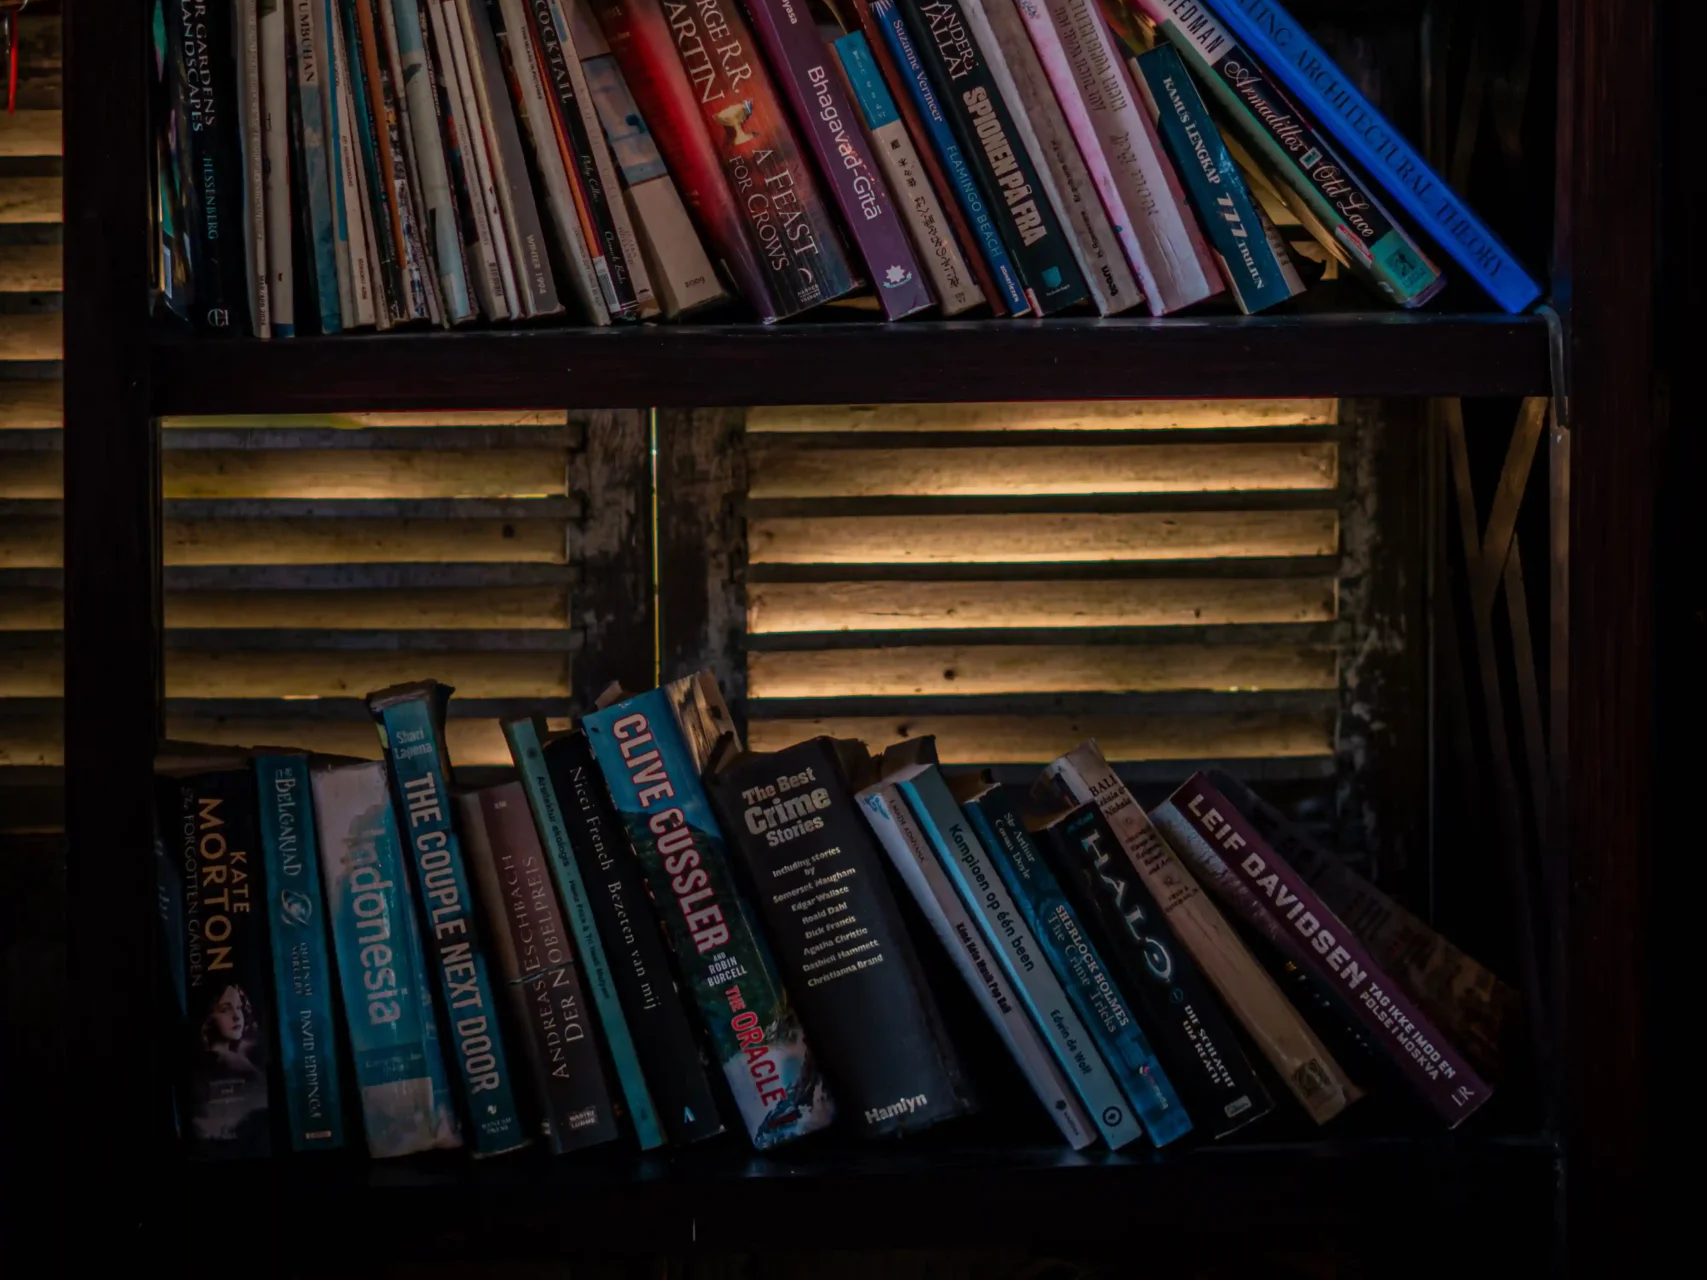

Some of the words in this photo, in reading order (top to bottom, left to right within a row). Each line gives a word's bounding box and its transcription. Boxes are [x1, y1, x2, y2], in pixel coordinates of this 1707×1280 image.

[195, 6, 215, 125] GARDENS
[715, 39, 757, 95] R.R.
[891, 18, 922, 71] Suzanne
[913, 69, 944, 124] Vermeer
[919, 0, 968, 82] JALLAI
[960, 83, 1018, 177] SPIONEN
[1161, 76, 1190, 123] KAMUS
[1183, 122, 1222, 187] LENGKAP
[1219, 52, 1309, 156] Armadillos
[1308, 159, 1350, 203] Old
[1334, 191, 1380, 241] Lace
[997, 169, 1033, 204] PÅ
[1291, 45, 1432, 201] ARCHITECTURAL
[1431, 199, 1506, 280] THEORY
[727, 154, 756, 194] FOR
[743, 190, 793, 273] CROWS
[750, 142, 775, 164] A
[763, 169, 821, 262] FEAST
[945, 143, 983, 213] FLAMINGO
[975, 213, 1002, 258] BEACH
[1010, 198, 1049, 247] FRA
[525, 233, 541, 269] WINTER
[534, 271, 546, 294] 1994
[1235, 239, 1265, 290] TRILIUN
[396, 730, 425, 744] Shari
[402, 771, 442, 827] THE
[741, 780, 777, 807] The
[775, 766, 817, 793] Best
[741, 784, 834, 837] Crime
[1088, 774, 1118, 797] BALI
[536, 775, 557, 823] Arsitektur
[549, 824, 570, 867] ekologis
[568, 765, 595, 811] Nicci
[584, 815, 614, 871] French
[610, 710, 676, 808] CLIVE
[646, 804, 733, 955] CUSSLER
[764, 814, 826, 848] Stories
[992, 817, 1016, 852] Conan
[1010, 851, 1032, 881] Doyle
[1003, 811, 1018, 828] Sir
[1012, 827, 1037, 863] Arthur
[182, 814, 199, 914] FORGOTTEN
[196, 796, 233, 971] MORTON
[230, 851, 251, 914] KATE
[415, 829, 467, 940] COUPLE
[770, 856, 811, 878] Including
[810, 845, 841, 862] stories
[771, 881, 815, 904] Somerset
[813, 866, 857, 888] Maugham
[803, 866, 816, 877] by
[1185, 792, 1246, 857] LEIF
[1239, 850, 1369, 991] DAVIDSEN
[341, 826, 413, 1025] Indonesia
[499, 853, 541, 971] ESCHBACH
[520, 853, 570, 988] NOBELPREIS
[606, 880, 638, 945] Bezeten
[790, 895, 818, 913] Edgar
[815, 884, 850, 901] Wallace
[801, 909, 827, 925] Roald
[826, 901, 848, 915] Dahl
[803, 925, 825, 939] Dick
[824, 914, 856, 931] Francis
[945, 822, 993, 895] Kampioen
[982, 891, 1002, 912] op
[995, 909, 1017, 937] één
[1010, 935, 1037, 972] been
[1076, 827, 1181, 986] HALO
[187, 919, 203, 986] GARDEN
[628, 948, 646, 977] van
[707, 955, 738, 975] ROBIN
[711, 951, 726, 961] AND
[801, 938, 834, 957] Agatha
[833, 926, 869, 944] Christie
[801, 954, 837, 972] Dashiell
[835, 938, 880, 960] Hammett
[806, 963, 858, 988] Christianna
[855, 953, 884, 970] Brand
[1044, 911, 1065, 935] The
[1062, 942, 1094, 987] Crime
[1088, 988, 1119, 1034] Tricks
[1053, 902, 1099, 974] SHERLOCK
[1092, 971, 1130, 1028] HOLMES
[439, 941, 483, 1013] NEXT
[636, 980, 661, 1011] mij
[705, 963, 748, 987] BURCELL
[723, 984, 747, 1013] THE
[299, 1009, 315, 1051] DAVID
[530, 978, 570, 1081] ANDREAS
[555, 994, 584, 1042] DER
[1049, 1008, 1072, 1039] Edwin
[1064, 1036, 1079, 1052] de
[1182, 1004, 1198, 1022] DIE
[1192, 1021, 1237, 1090] SCHLACHT
[1365, 981, 1392, 1009] TAG
[1385, 1003, 1415, 1035] IKKE
[1410, 1030, 1442, 1064] IMOD
[1435, 1058, 1457, 1080] EN
[455, 1014, 500, 1095] DOOR
[728, 1008, 790, 1107] ORACLE
[1193, 1043, 1222, 1084] REACH
[1395, 1030, 1442, 1081] MOSKVA
[303, 1054, 322, 1119] EDDINGS
[863, 1091, 929, 1126] Hamlyn
